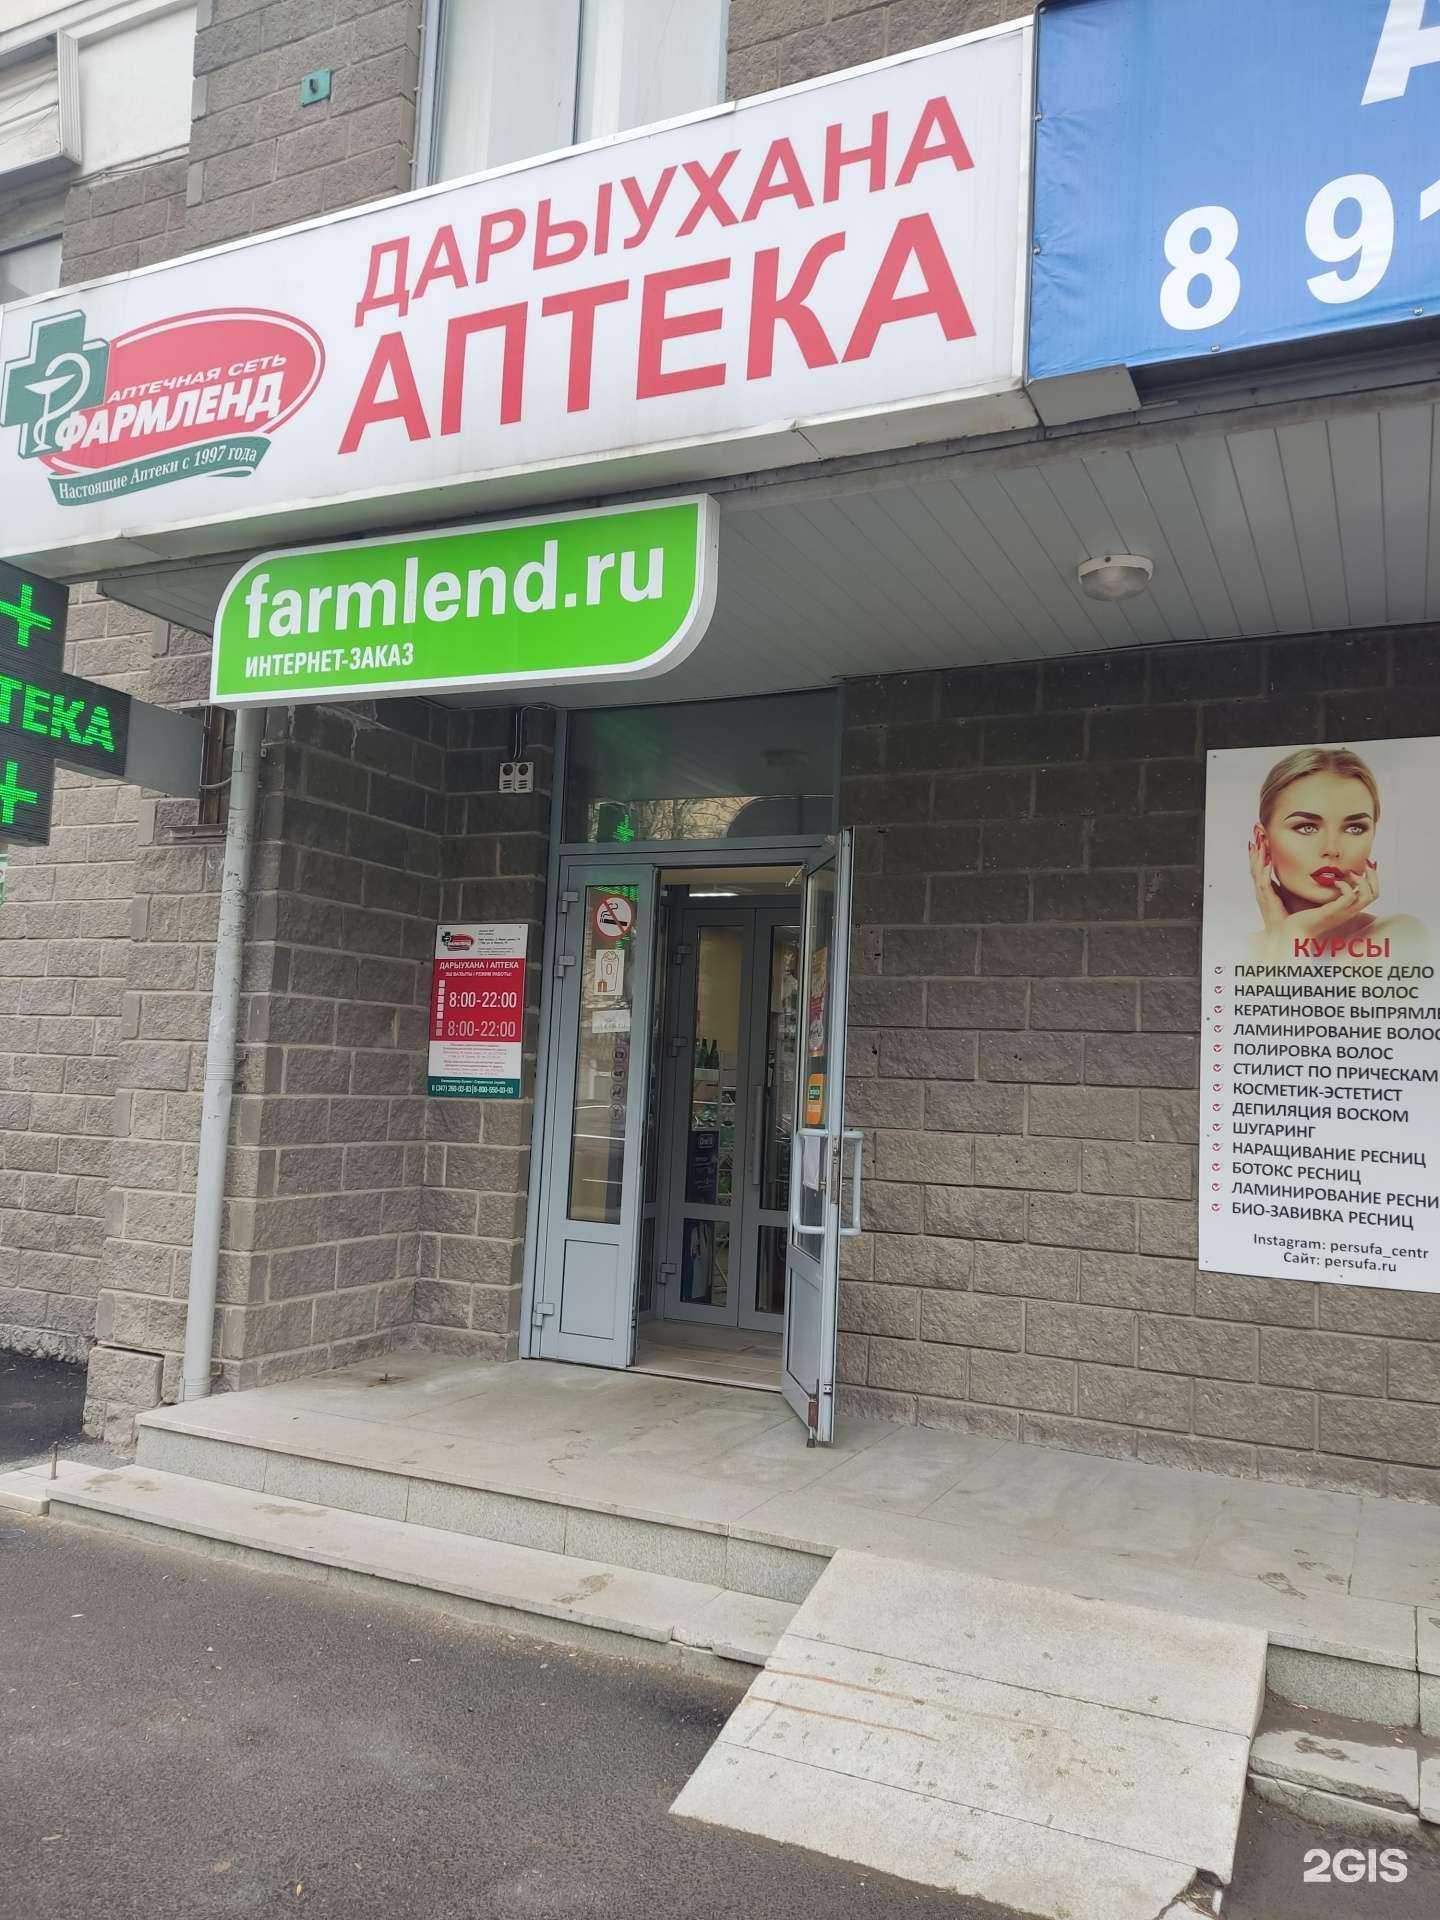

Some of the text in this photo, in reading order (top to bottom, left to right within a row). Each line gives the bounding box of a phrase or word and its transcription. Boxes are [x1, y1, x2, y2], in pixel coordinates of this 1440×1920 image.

[354, 96, 976, 327] ДАРЫУХАНА
[1159, 173, 1440, 331] 8 9
[338, 212, 977, 455] АПТЕКА
[107, 353, 287, 403] АПТЕЧНАЯ СЕТЬ
[54, 371, 285, 452] ФАРМЛЕНД
[58, 445, 258, 499] Настоящие Аптеки с 1997 года
[244, 539, 665, 639] farmlend.ru
[245, 642, 415, 678] ИНТЕРНЕТ-ЗАКАЗ
[1294, 937, 1391, 958] КУРСЫ
[490, 961, 520, 969] АПТЕКА
[1235, 965, 1435, 980] ПАРИКМАХЕРСКОЕ ДЕЛО
[449, 991, 517, 1008] 8:00-22:00
[1234, 984, 1419, 999] НАРАЩИВАНИЕ ВОЛОС
[1234, 1005, 1440, 1020] КЕРАТИНОВОЕ ВЫПРЯМЛ
[447, 1020, 516, 1037] 8:00-22:00
[1233, 1024, 1382, 1039] ЛАМИНИРОВАНИЕ
[1233, 1043, 1394, 1060] ПОЛИРОВКА ВОЛОС
[1233, 1063, 1438, 1082] СТИЛИСТ ПО ПРИЧЕСКАМ
[1233, 1083, 1403, 1101] КОСМЕТИК-ЭСТЕТИСТ
[1232, 1102, 1410, 1122] ДЕПИЛЯЦИЯ ВОСКОМ
[1232, 1122, 1317, 1138] ШУГАРИНГ
[1232, 1142, 1427, 1168] НАРАЩИВАНИЕ РЕСНИЦ
[1232, 1161, 1362, 1184] БОТОКС РЕСНИЦ
[1231, 1182, 1381, 1205] ЛАМИНИРОВАНИЕ
[1232, 1202, 1414, 1231] БИО-ЗАВИВКА РЕСНИЦ
[1254, 1233, 1429, 1259] Instagram: persufa_centr
[1283, 1252, 1397, 1272] Сайт: persufa.ru
